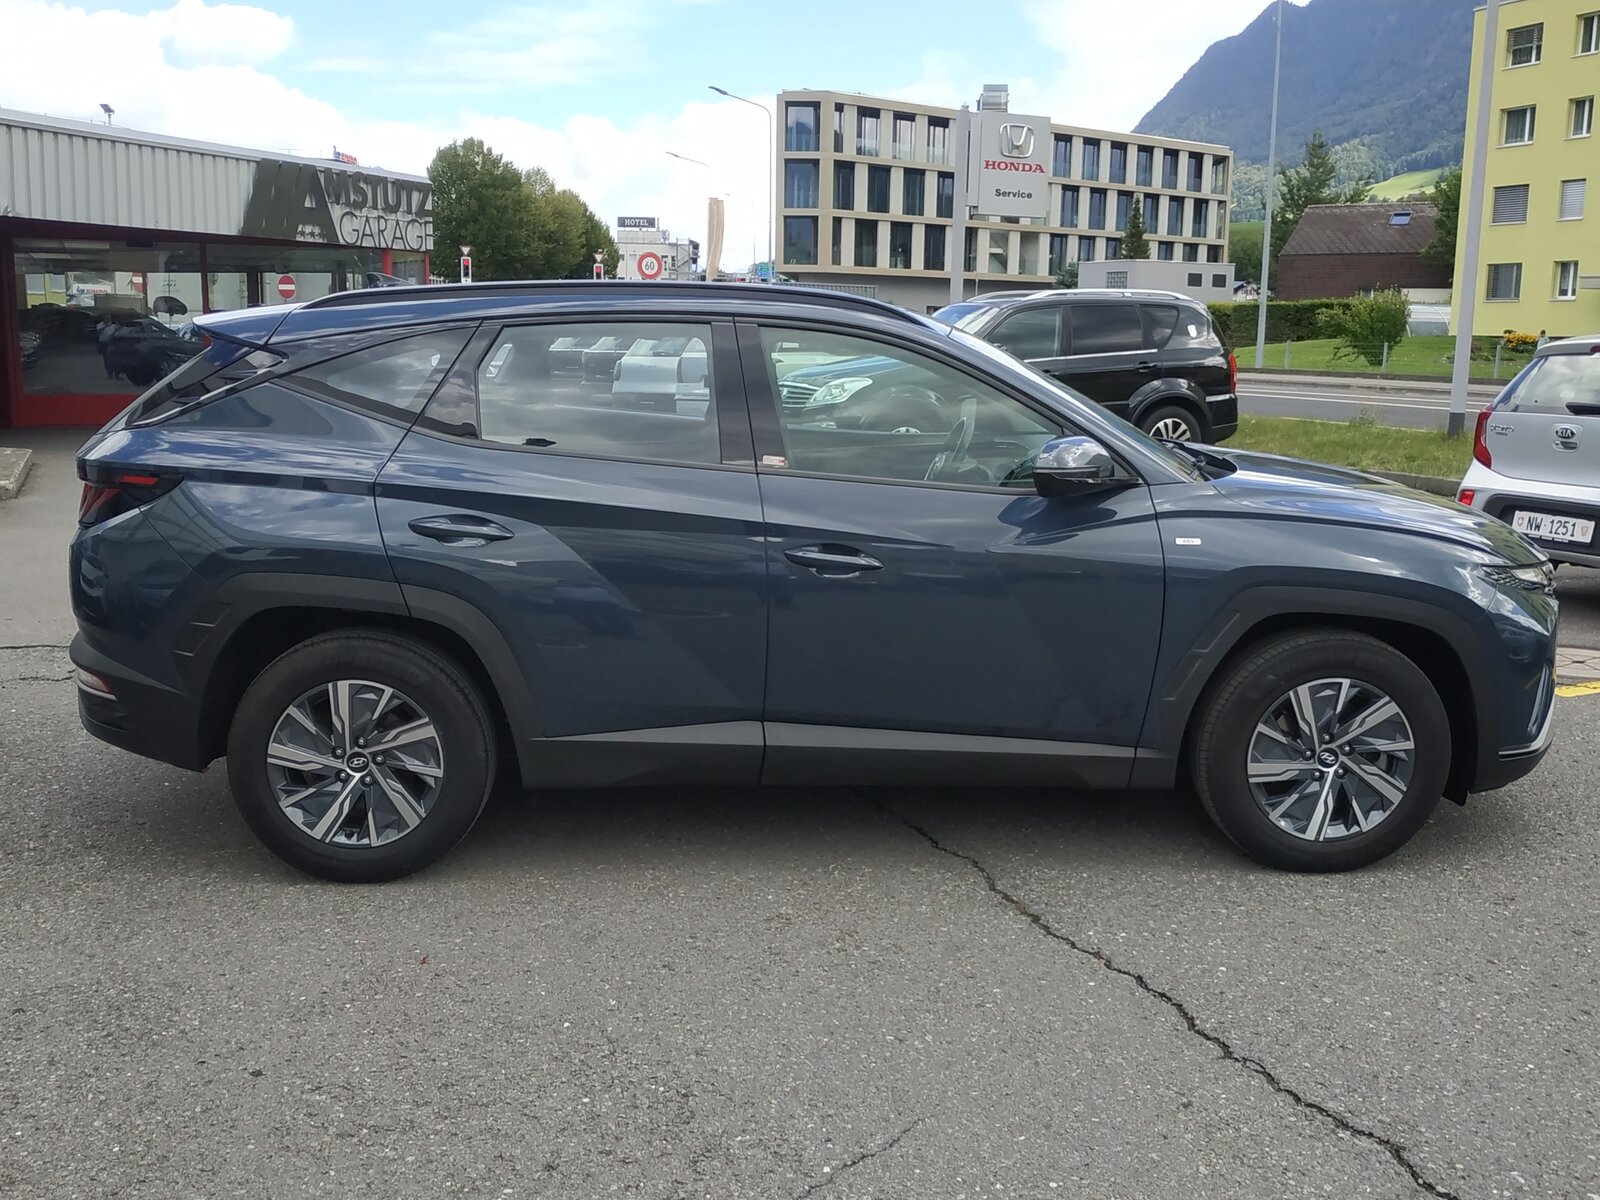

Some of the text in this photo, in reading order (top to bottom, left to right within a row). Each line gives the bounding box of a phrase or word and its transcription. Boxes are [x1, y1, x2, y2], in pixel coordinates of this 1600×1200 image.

[983, 160, 1046, 174] HONDA
[994, 188, 1033, 199] Service
[274, 162, 433, 244] AMSTUTZ
[624, 218, 649, 226] HOTEL
[340, 211, 433, 250] GARAGE
[644, 261, 655, 271] 60
[1557, 428, 1573, 438] KIA
[1549, 519, 1577, 538] 1251
